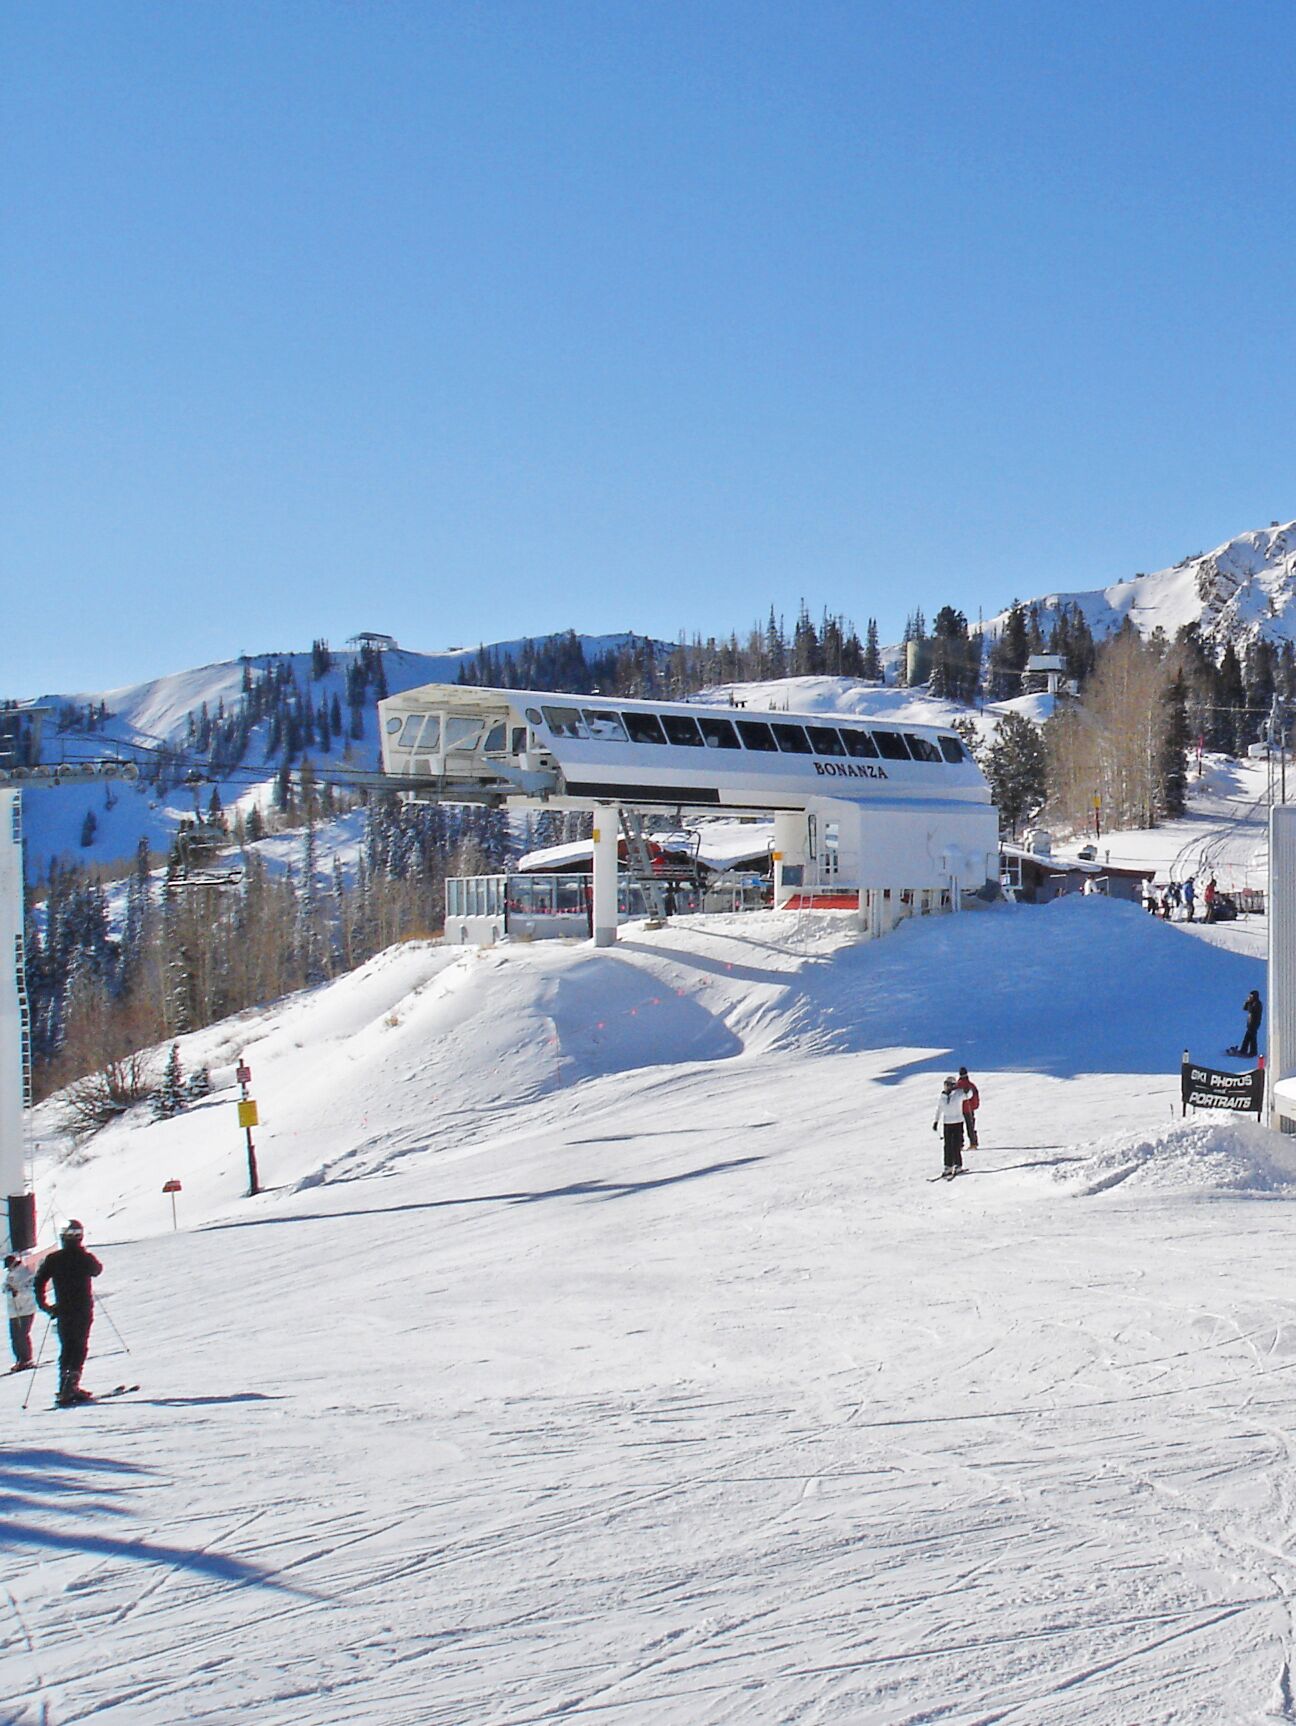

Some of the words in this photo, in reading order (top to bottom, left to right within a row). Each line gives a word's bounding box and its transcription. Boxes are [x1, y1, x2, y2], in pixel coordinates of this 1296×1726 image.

[813, 762, 888, 779] BONANZA
[1190, 1069, 1207, 1083] SKI
[1210, 1074, 1253, 1087] PHOTOS
[1189, 1091, 1252, 1109] PORTRAITS
